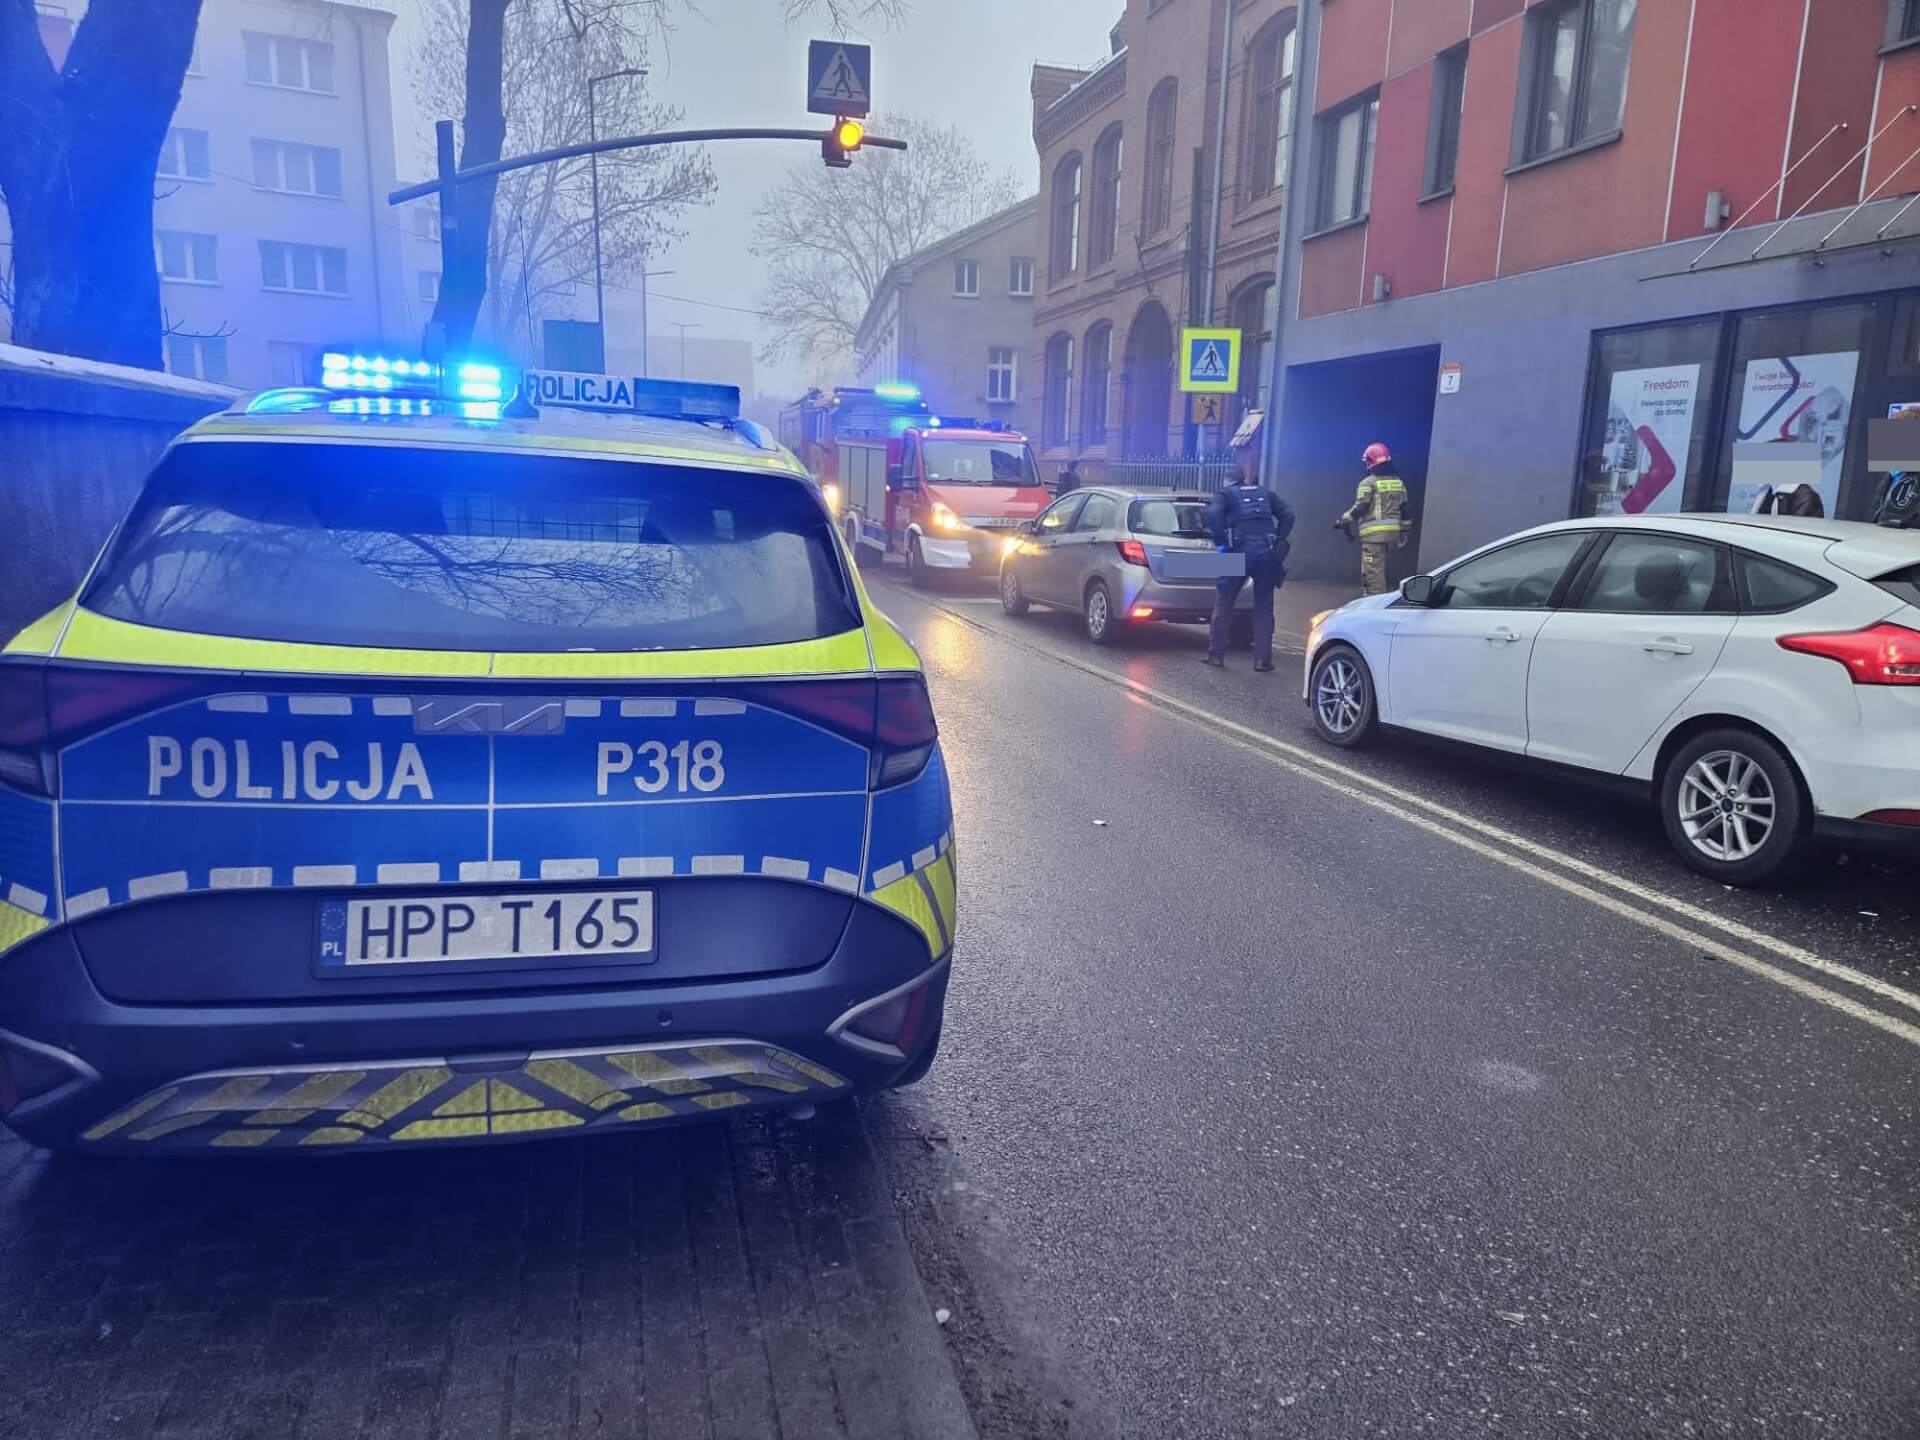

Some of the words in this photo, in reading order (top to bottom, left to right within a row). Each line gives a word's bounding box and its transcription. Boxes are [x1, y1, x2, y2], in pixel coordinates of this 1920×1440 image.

[1447, 375, 1454, 386] 7
[1643, 380, 1689, 391] Freedom
[1752, 380, 1815, 392] nieruchoości
[1654, 408, 1664, 416] do
[148, 736, 434, 800] POLICJA
[597, 740, 725, 796] P318
[360, 903, 475, 960] HPP
[501, 897, 640, 953] T165
[321, 942, 343, 957] PL
